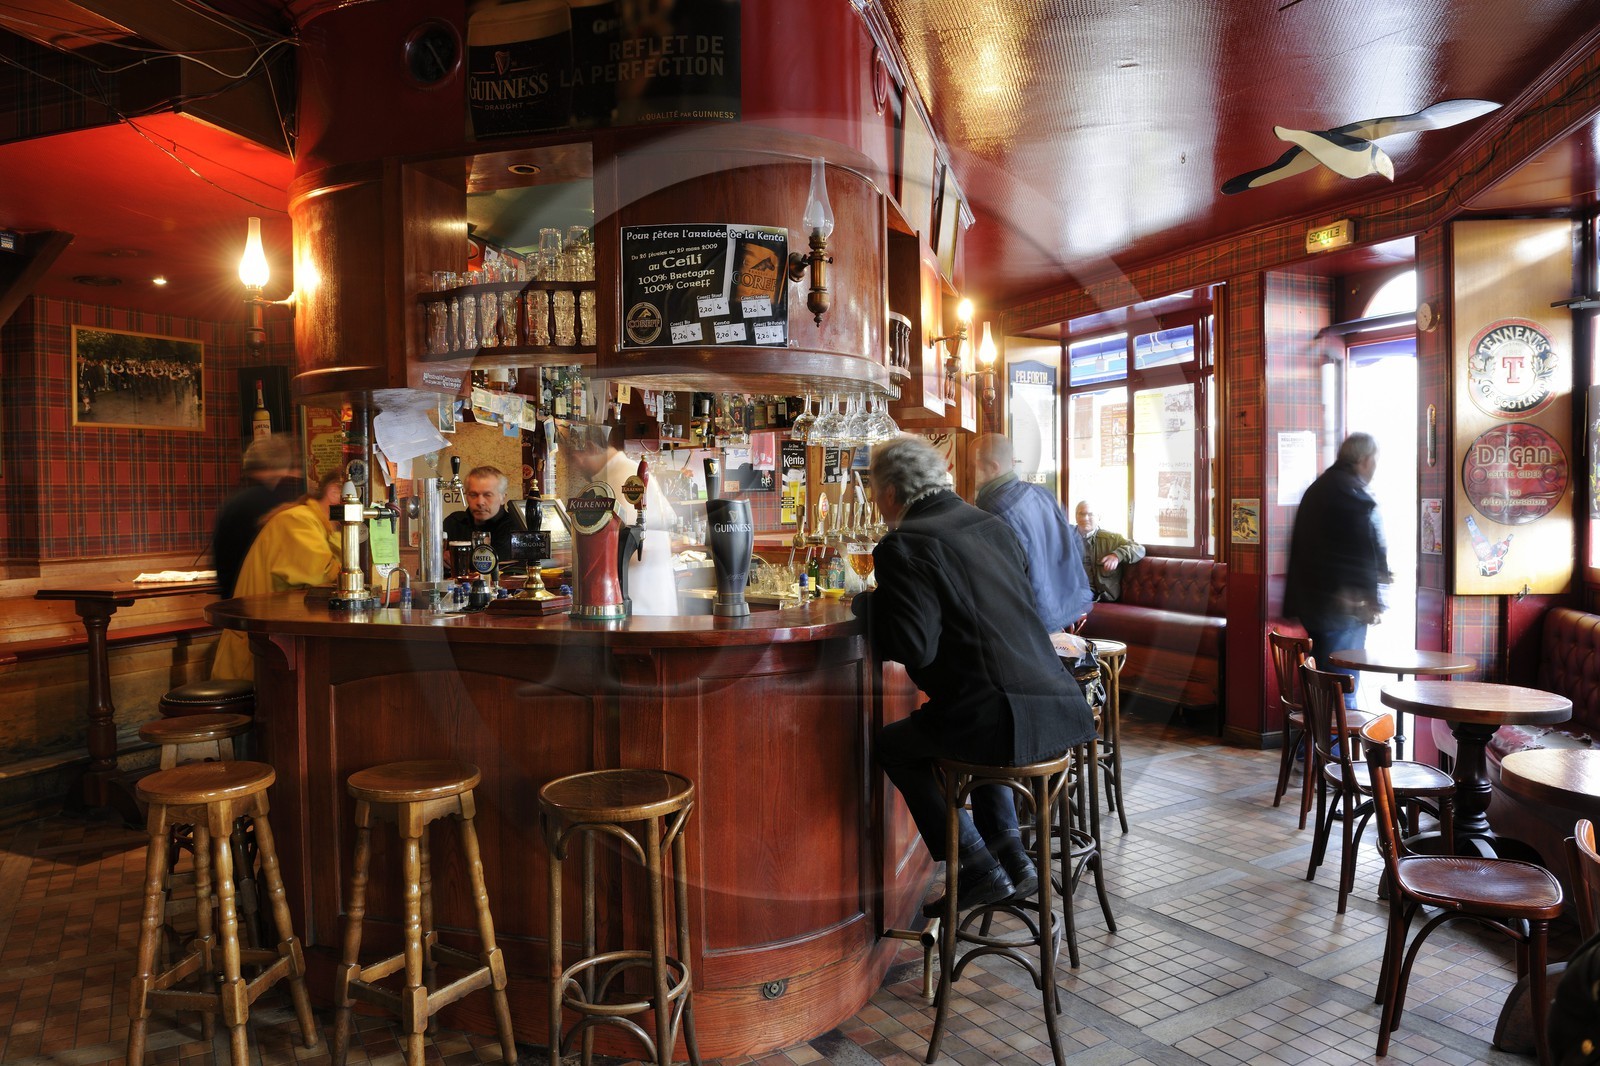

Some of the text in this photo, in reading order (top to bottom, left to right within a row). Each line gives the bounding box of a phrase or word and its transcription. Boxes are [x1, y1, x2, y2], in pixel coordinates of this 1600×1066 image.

[609, 36, 724, 61] REFLET DE
[560, 57, 724, 88] LA PERFECTION
[470, 72, 549, 100] GUINNESS
[484, 102, 524, 110] DRAUGHT
[646, 110, 678, 120] QUALITÉ
[692, 110, 734, 118] GUINNESS
[626, 229, 784, 242] Pour fêter l'arrivée de la Kenta
[648, 264, 660, 272] au
[638, 268, 715, 285] 100% Bretagne
[644, 278, 711, 294] 100% Coreff
[1478, 326, 1550, 352] TENNENT'S
[1016, 370, 1048, 384] PELFORTH
[1502, 356, 1524, 384] T
[784, 454, 804, 468] Kenta
[1476, 444, 1552, 469] DAGAN
[1517, 470, 1542, 478] CIDER
[569, 500, 612, 510] KILKENNY
[714, 523, 752, 533] GUINNESS
